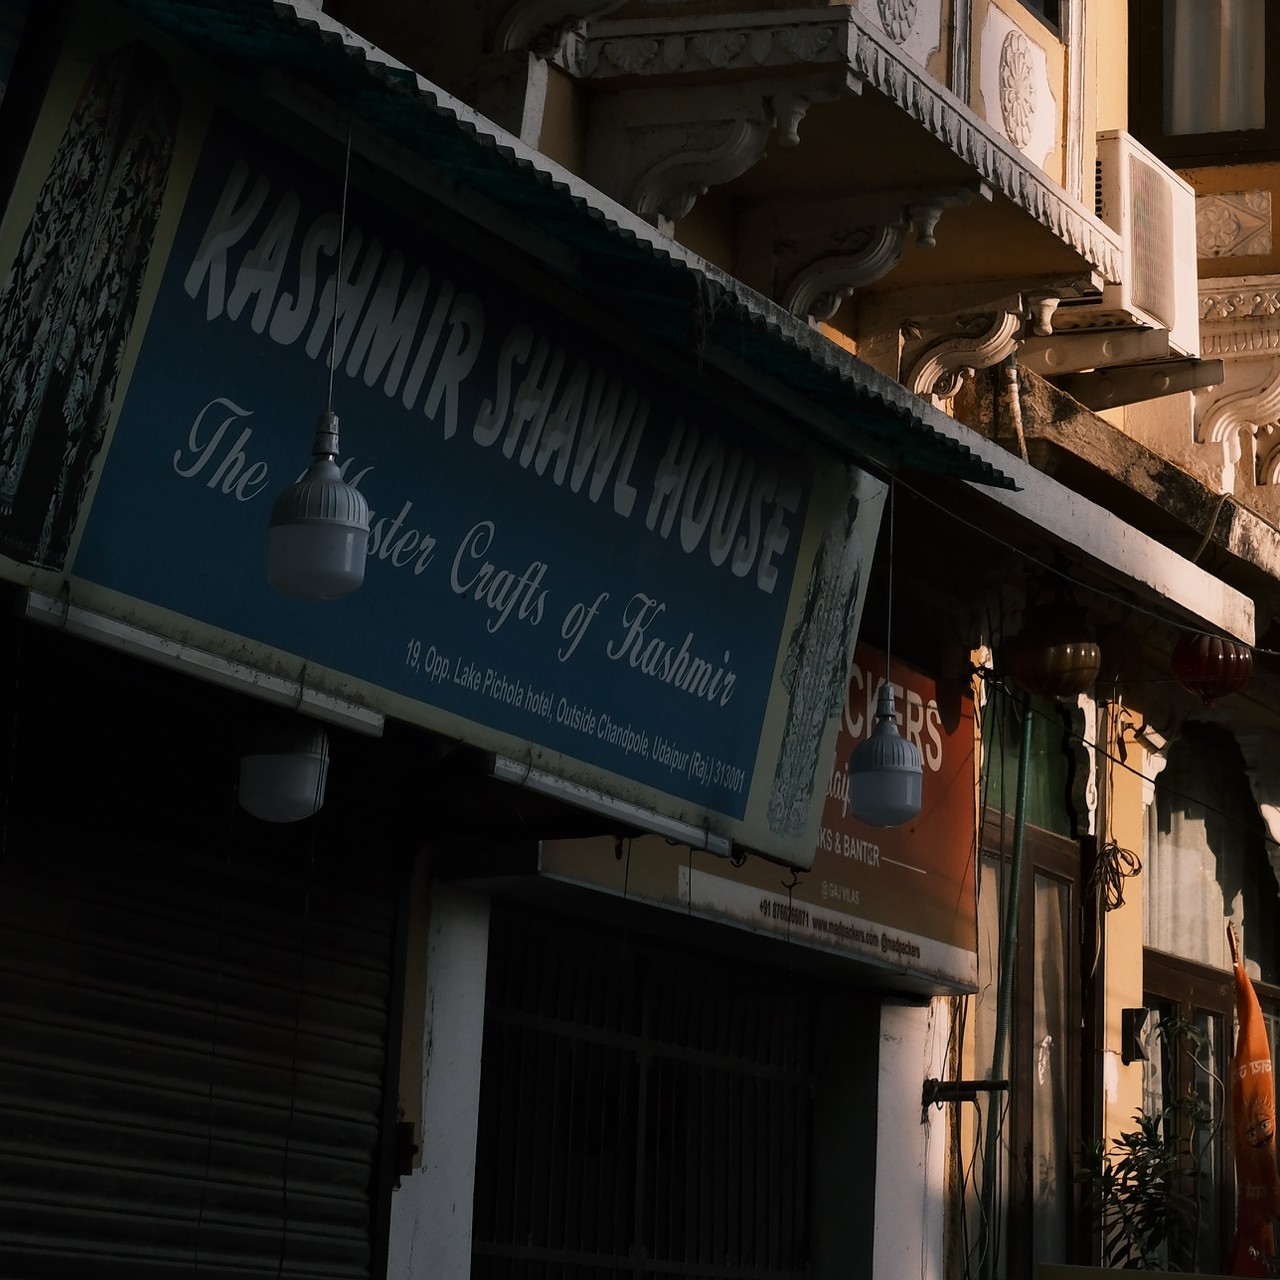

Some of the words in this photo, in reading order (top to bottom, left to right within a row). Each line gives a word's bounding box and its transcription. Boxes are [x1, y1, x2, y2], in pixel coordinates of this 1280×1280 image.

[184, 158, 485, 440] KASHMIR
[473, 324, 649, 518] SHAWL
[646, 414, 800, 594] HOUSE
[173, 397, 269, 501] The
[295, 457, 437, 575] ster
[450, 520, 549, 633] Crafts
[558, 592, 609, 662] of
[606, 592, 737, 706] Kashmir
[405, 638, 421, 673] 19,
[425, 645, 451, 684] Opp.
[453, 657, 482, 691] Lake
[482, 668, 524, 707] Pichola
[524, 684, 555, 724] hotel,
[556, 697, 596, 735] Outside
[597, 713, 650, 761] Chandpole,
[652, 735, 689, 773] Udaipur
[688, 750, 714, 787] (Raj.)
[714, 760, 746, 793] 313001
[834, 834, 842, 855] &
[844, 835, 880, 867] BANTER
[759, 899, 771, 917] +91
[881, 933, 921, 958] @madpackers
